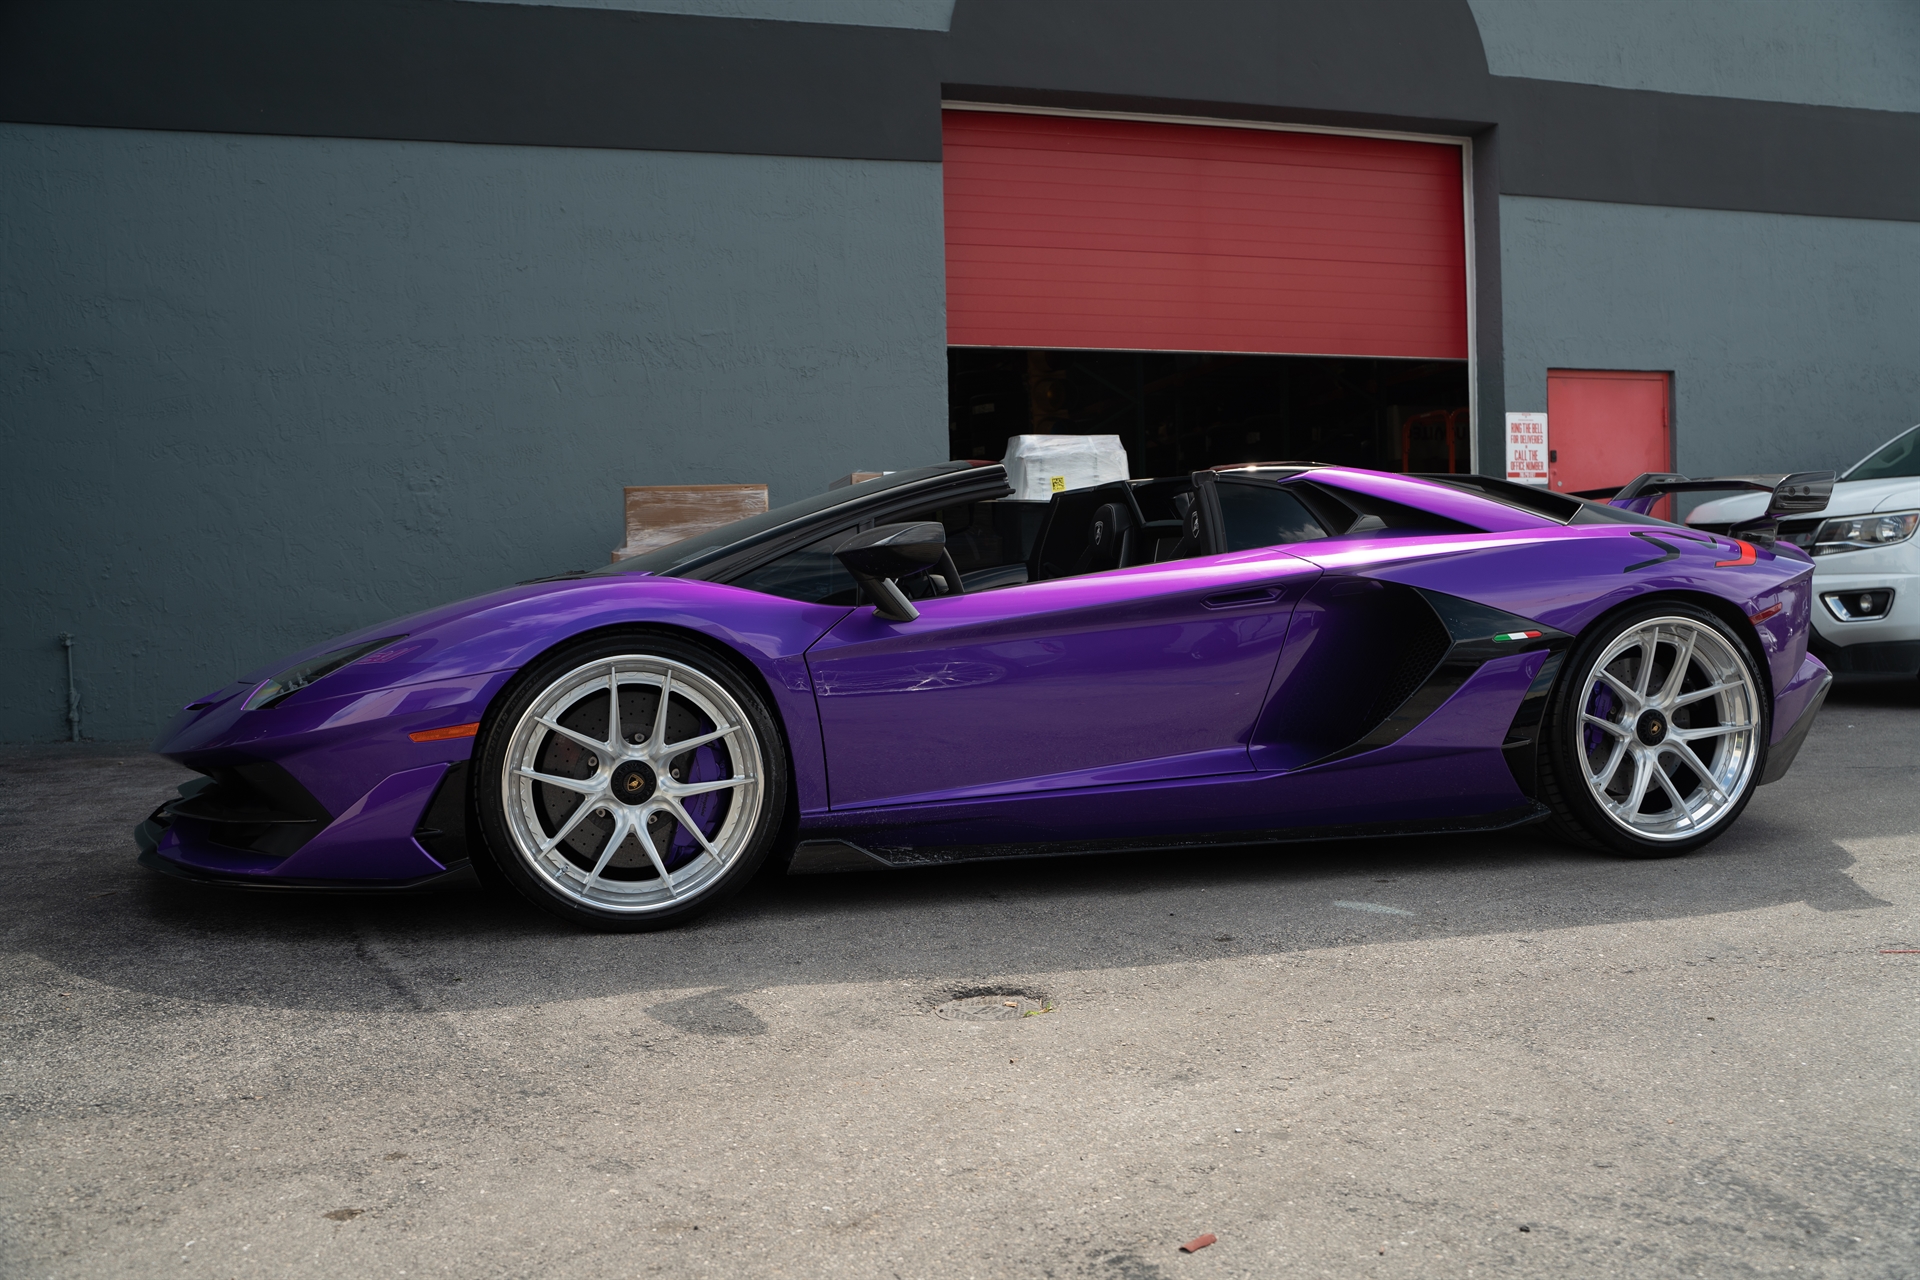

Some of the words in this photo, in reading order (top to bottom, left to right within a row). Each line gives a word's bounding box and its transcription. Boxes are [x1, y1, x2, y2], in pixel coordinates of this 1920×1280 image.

[1511, 423, 1522, 434] RING
[1523, 423, 1531, 434] THE
[1532, 423, 1543, 434] BELL
[1511, 435, 1519, 444] FOR
[1520, 435, 1544, 444] DELIVERIES
[1514, 450, 1528, 461] CALL
[1528, 450, 1538, 461] THE
[1510, 462, 1525, 470] OFFICE
[1526, 462, 1544, 470] NUMBER
[486, 712, 509, 772] MICHELIN
